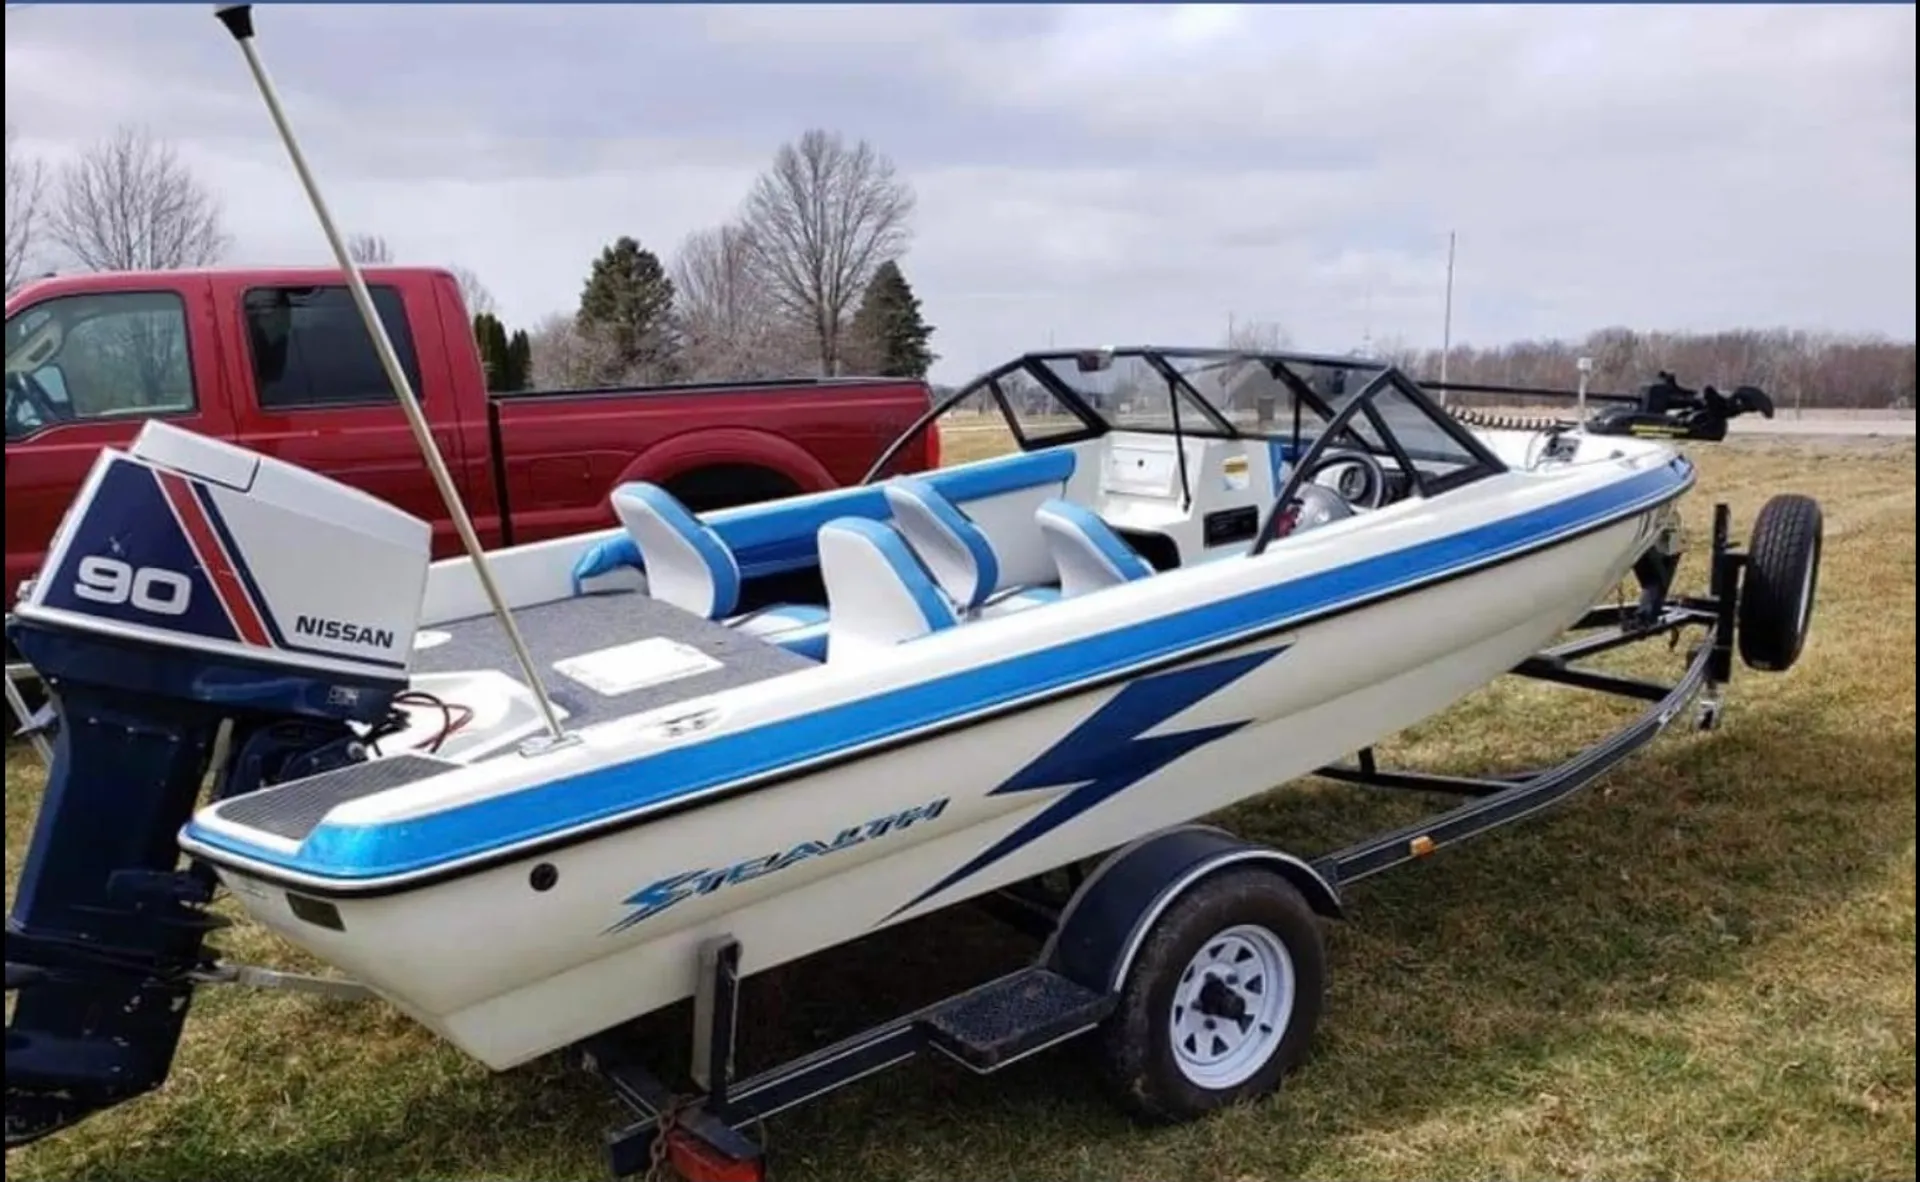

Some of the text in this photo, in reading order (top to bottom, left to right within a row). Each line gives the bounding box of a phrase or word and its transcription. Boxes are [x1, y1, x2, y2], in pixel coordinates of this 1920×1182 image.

[74, 556, 192, 615] 90
[295, 616, 394, 649] NISSAN
[605, 797, 950, 931] STEALTH
